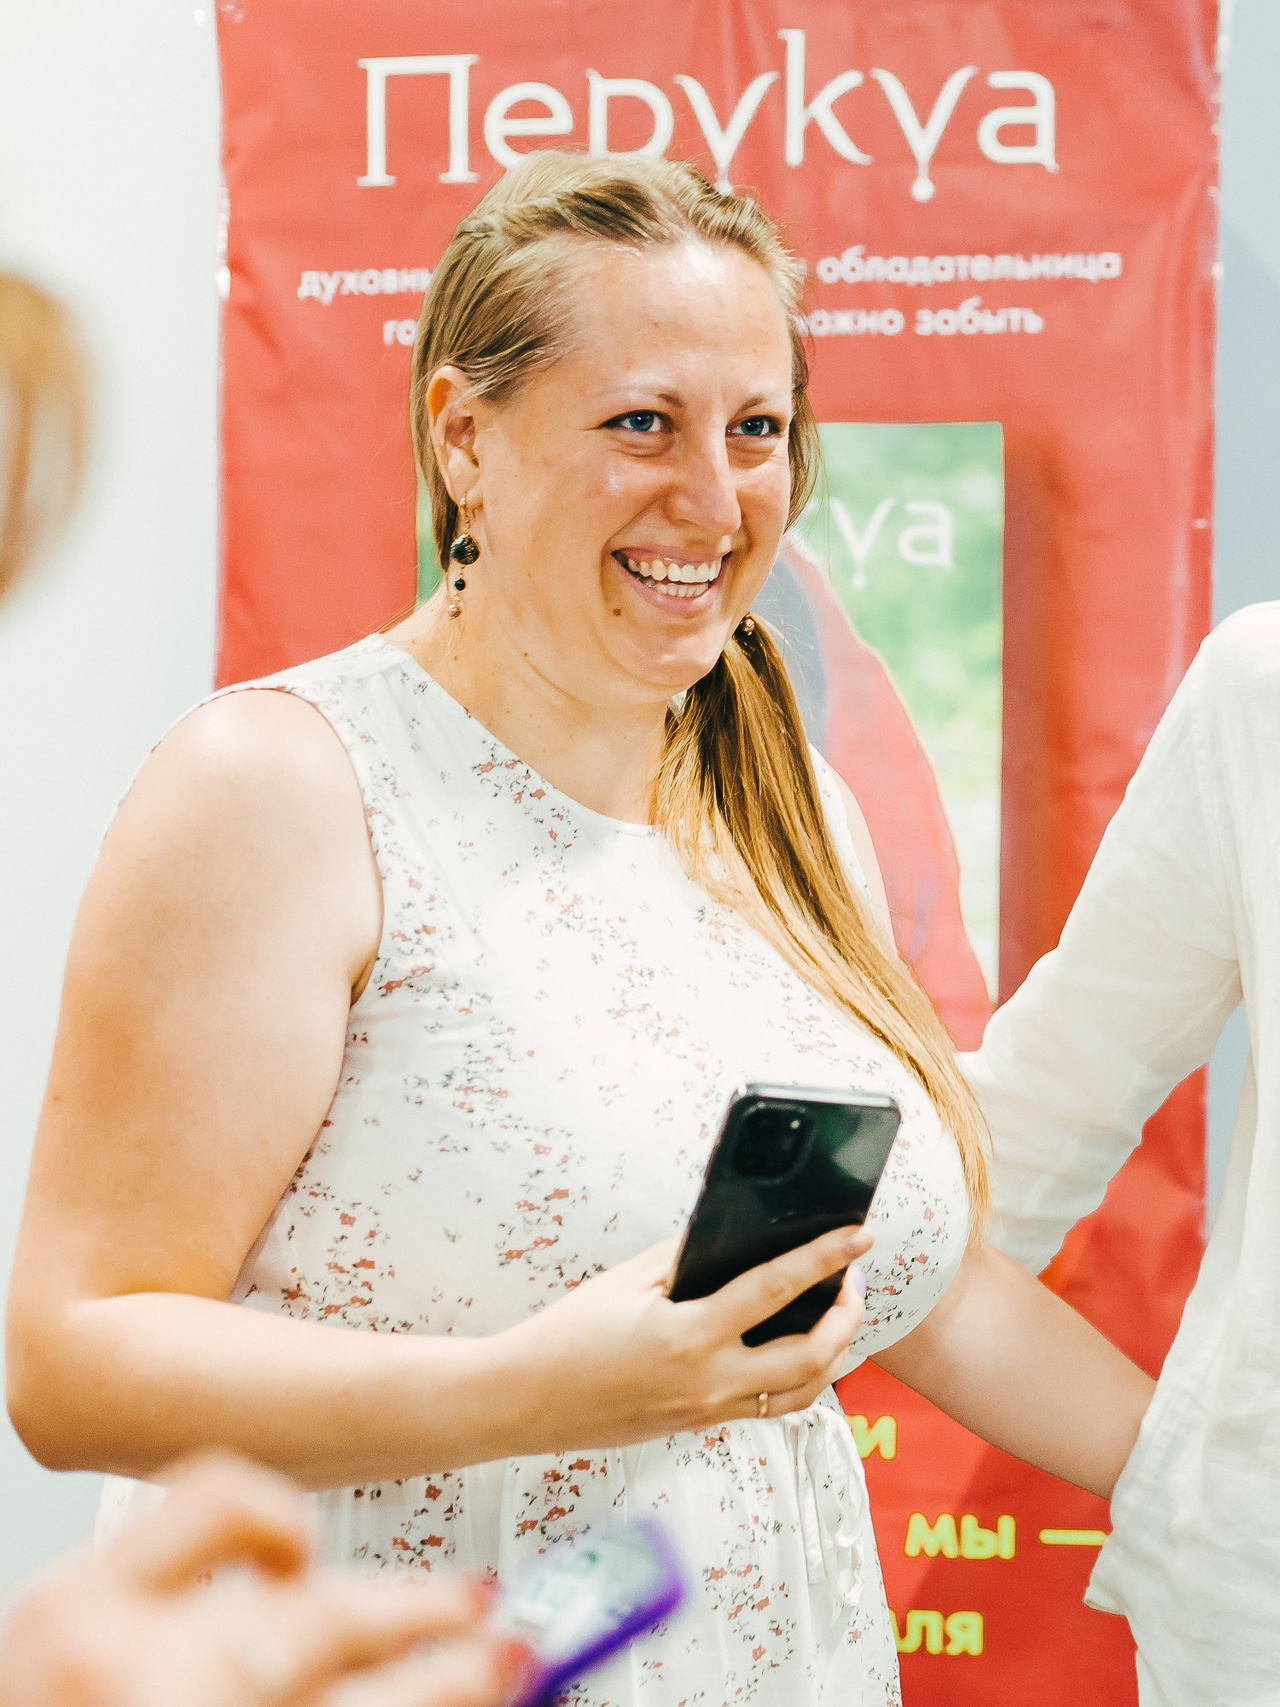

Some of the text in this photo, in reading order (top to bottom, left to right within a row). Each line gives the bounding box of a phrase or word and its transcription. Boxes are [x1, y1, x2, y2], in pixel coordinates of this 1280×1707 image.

[816, 244, 1122, 287] обладательница
[914, 295, 1045, 337] забыть
[903, 1511, 1017, 1561] мы
